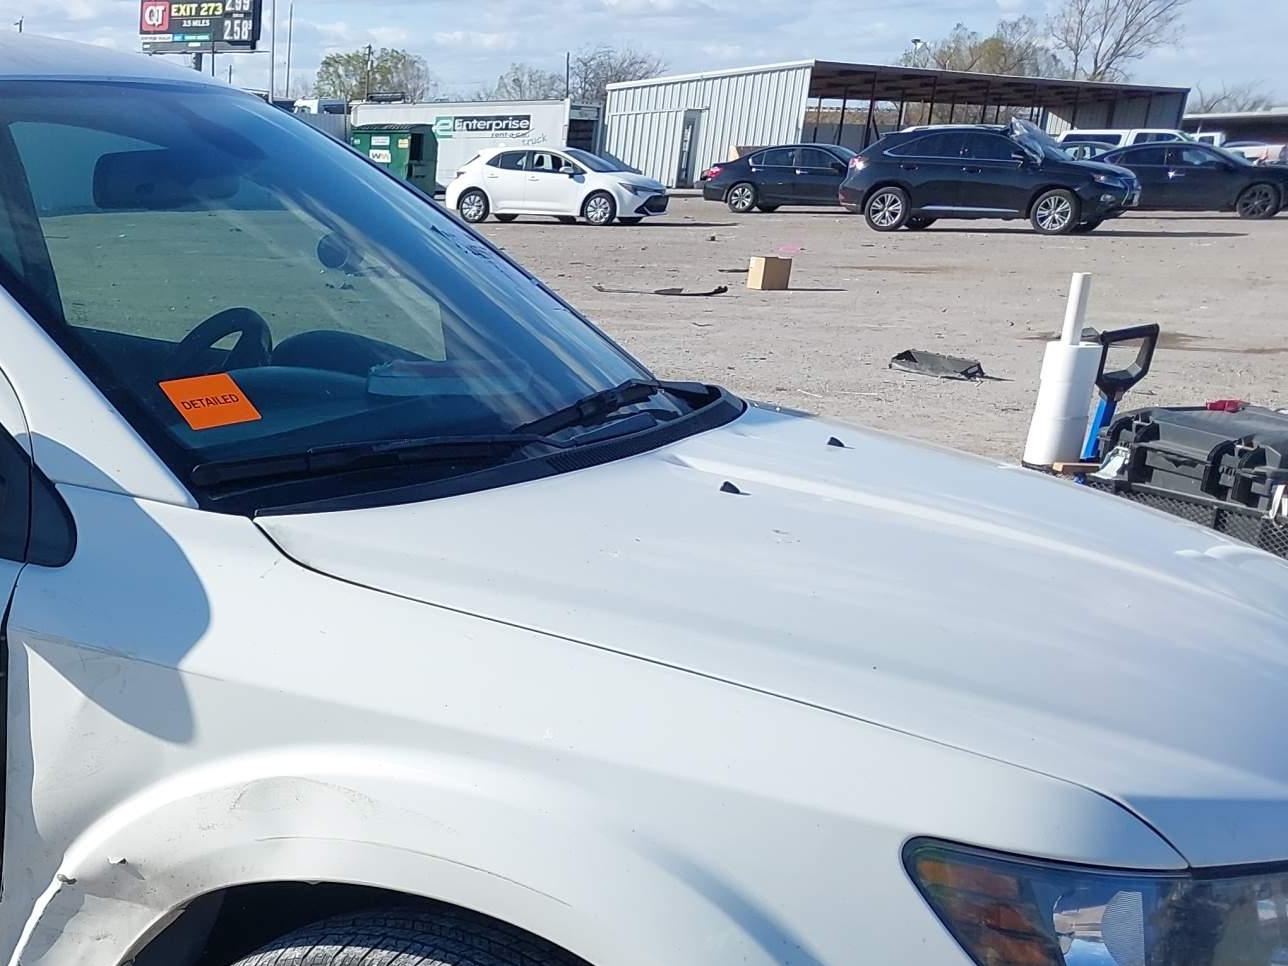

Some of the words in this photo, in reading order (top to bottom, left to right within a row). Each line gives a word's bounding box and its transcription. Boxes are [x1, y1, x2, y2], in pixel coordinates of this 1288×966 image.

[144, 5, 165, 27] QT
[171, 4, 198, 16] EXIT
[200, 3, 223, 16] 273
[455, 117, 529, 132] Enterprise
[180, 393, 240, 411] DETAILED
